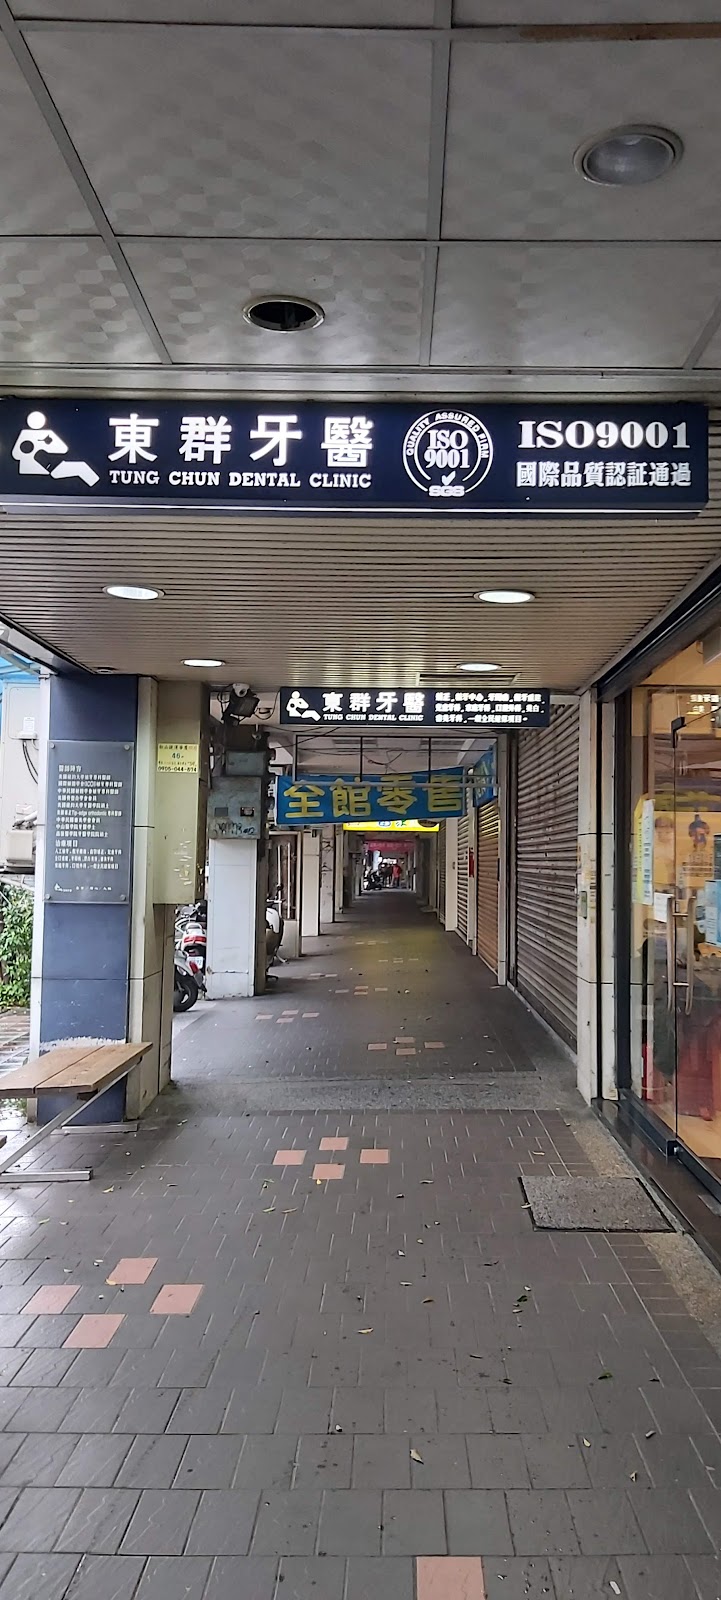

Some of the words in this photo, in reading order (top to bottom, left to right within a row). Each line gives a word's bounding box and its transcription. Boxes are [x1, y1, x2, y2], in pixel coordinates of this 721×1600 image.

[108, 413, 374, 468] 東群牙醫
[406, 417, 431, 456] QUALITY
[435, 412, 481, 433] ASSURED
[477, 433, 490, 459] FIRM
[427, 429, 469, 450] ISO
[517, 420, 691, 449] ISO9001
[424, 448, 471, 469] 9001
[109, 470, 160, 485] TUNG
[168, 471, 221, 487] CHUN
[228, 472, 301, 488] DENTAL
[309, 473, 372, 489] CLINIC
[516, 461, 692, 488] 國際品質認証通過
[428, 485, 465, 497] SGS
[322, 691, 425, 714] 東群牙醫
[322, 713, 344, 721] TUNG
[345, 713, 367, 721] CHUN
[398, 714, 424, 722] CLINIC
[283, 774, 463, 819] 全館零售
